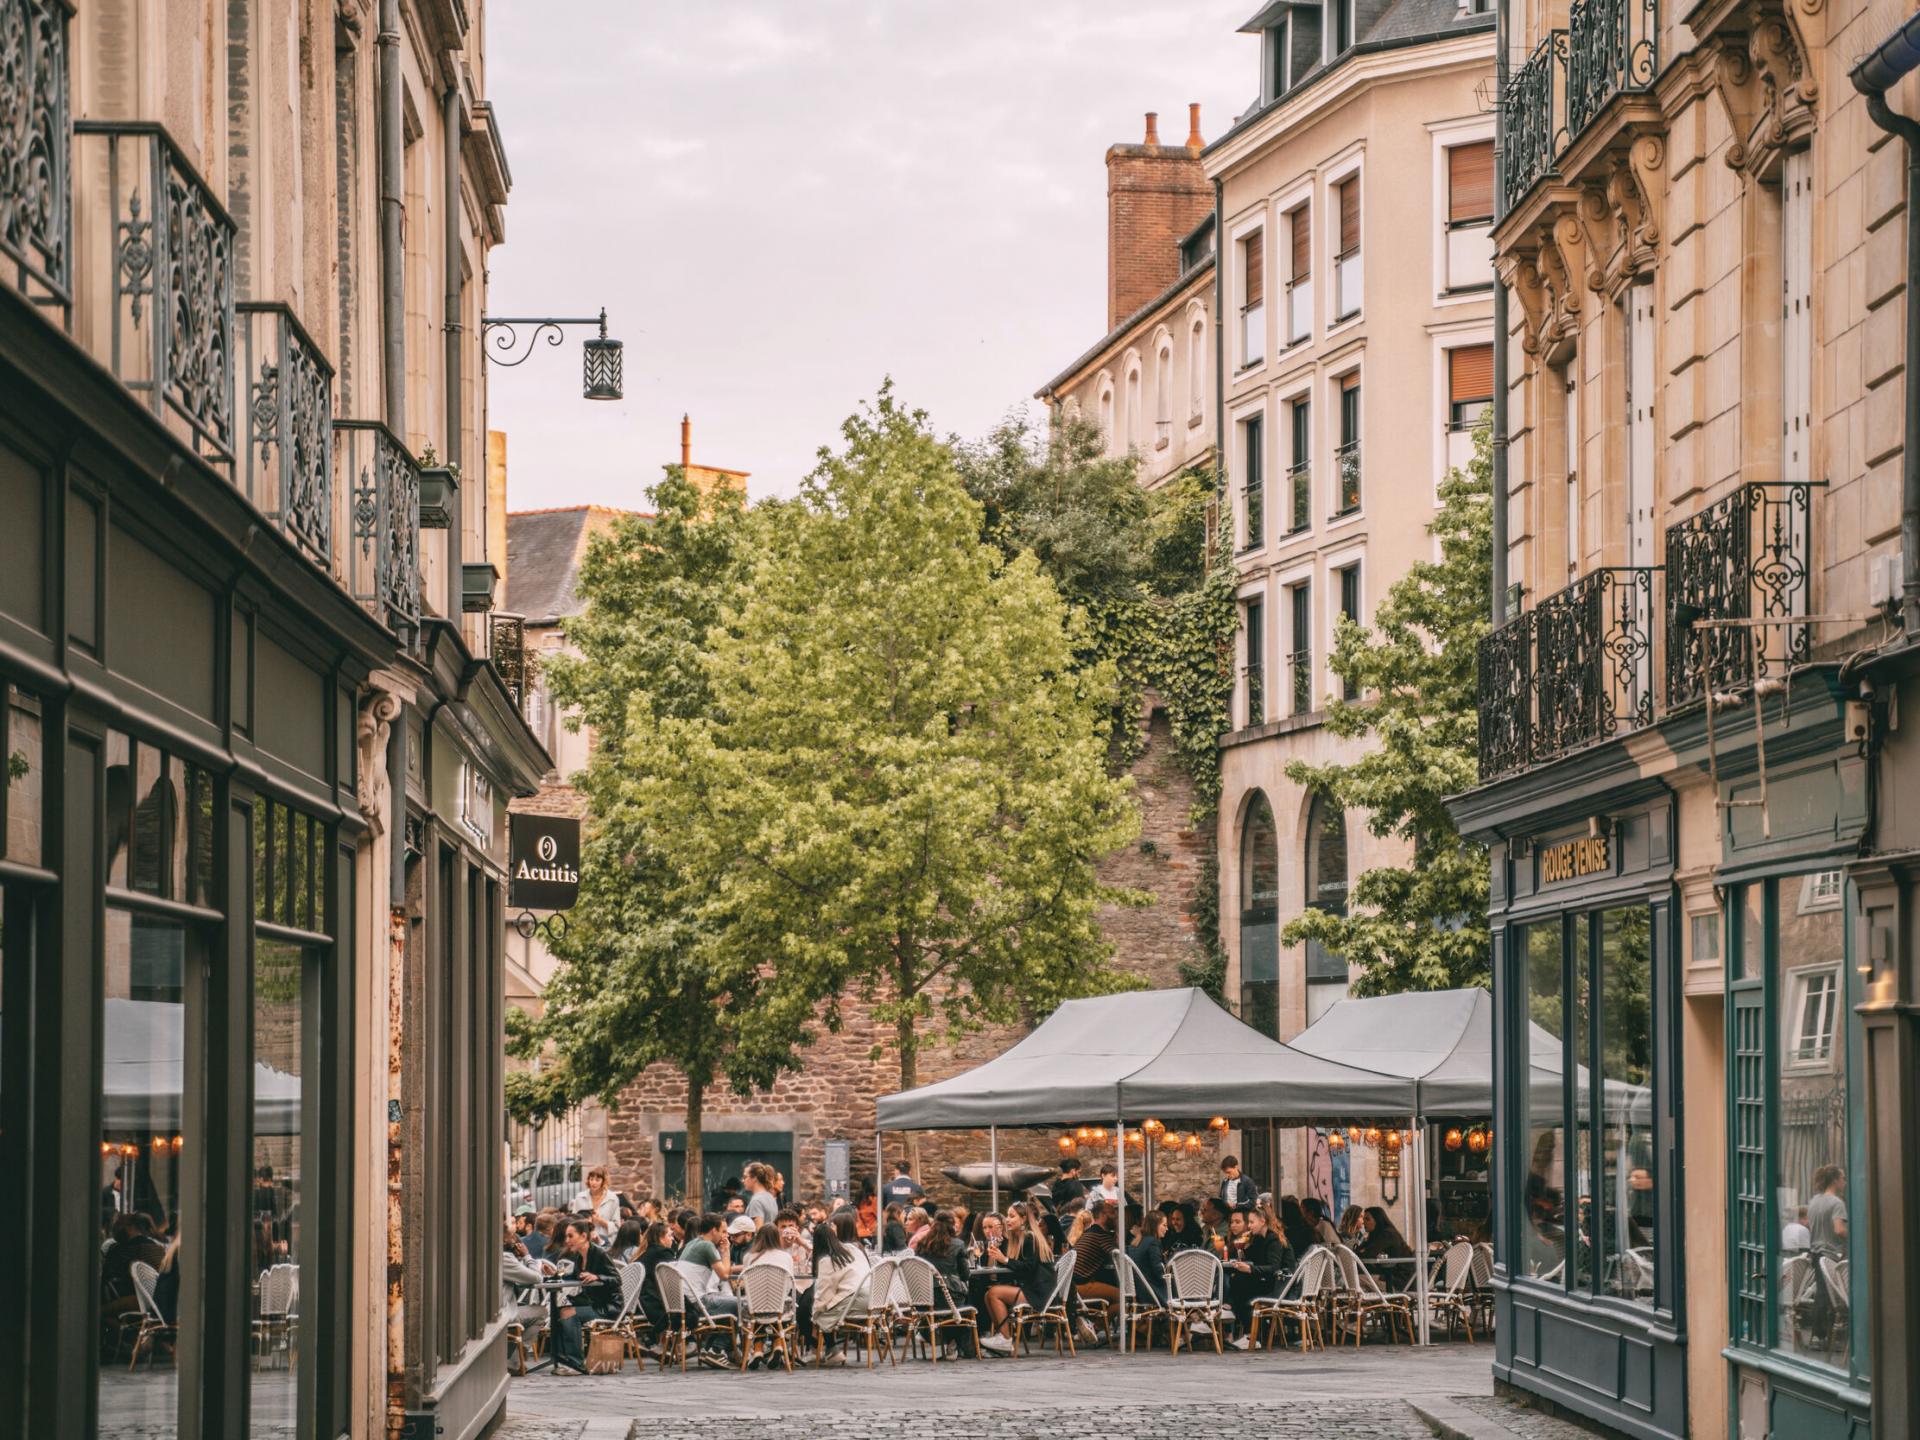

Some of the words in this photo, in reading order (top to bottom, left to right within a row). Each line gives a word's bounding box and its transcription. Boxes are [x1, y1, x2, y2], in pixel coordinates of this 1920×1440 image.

[516, 859, 578, 883] Acuitis
[1543, 844, 1573, 882] ROUGE
[1575, 839, 1607, 876] VENISE
